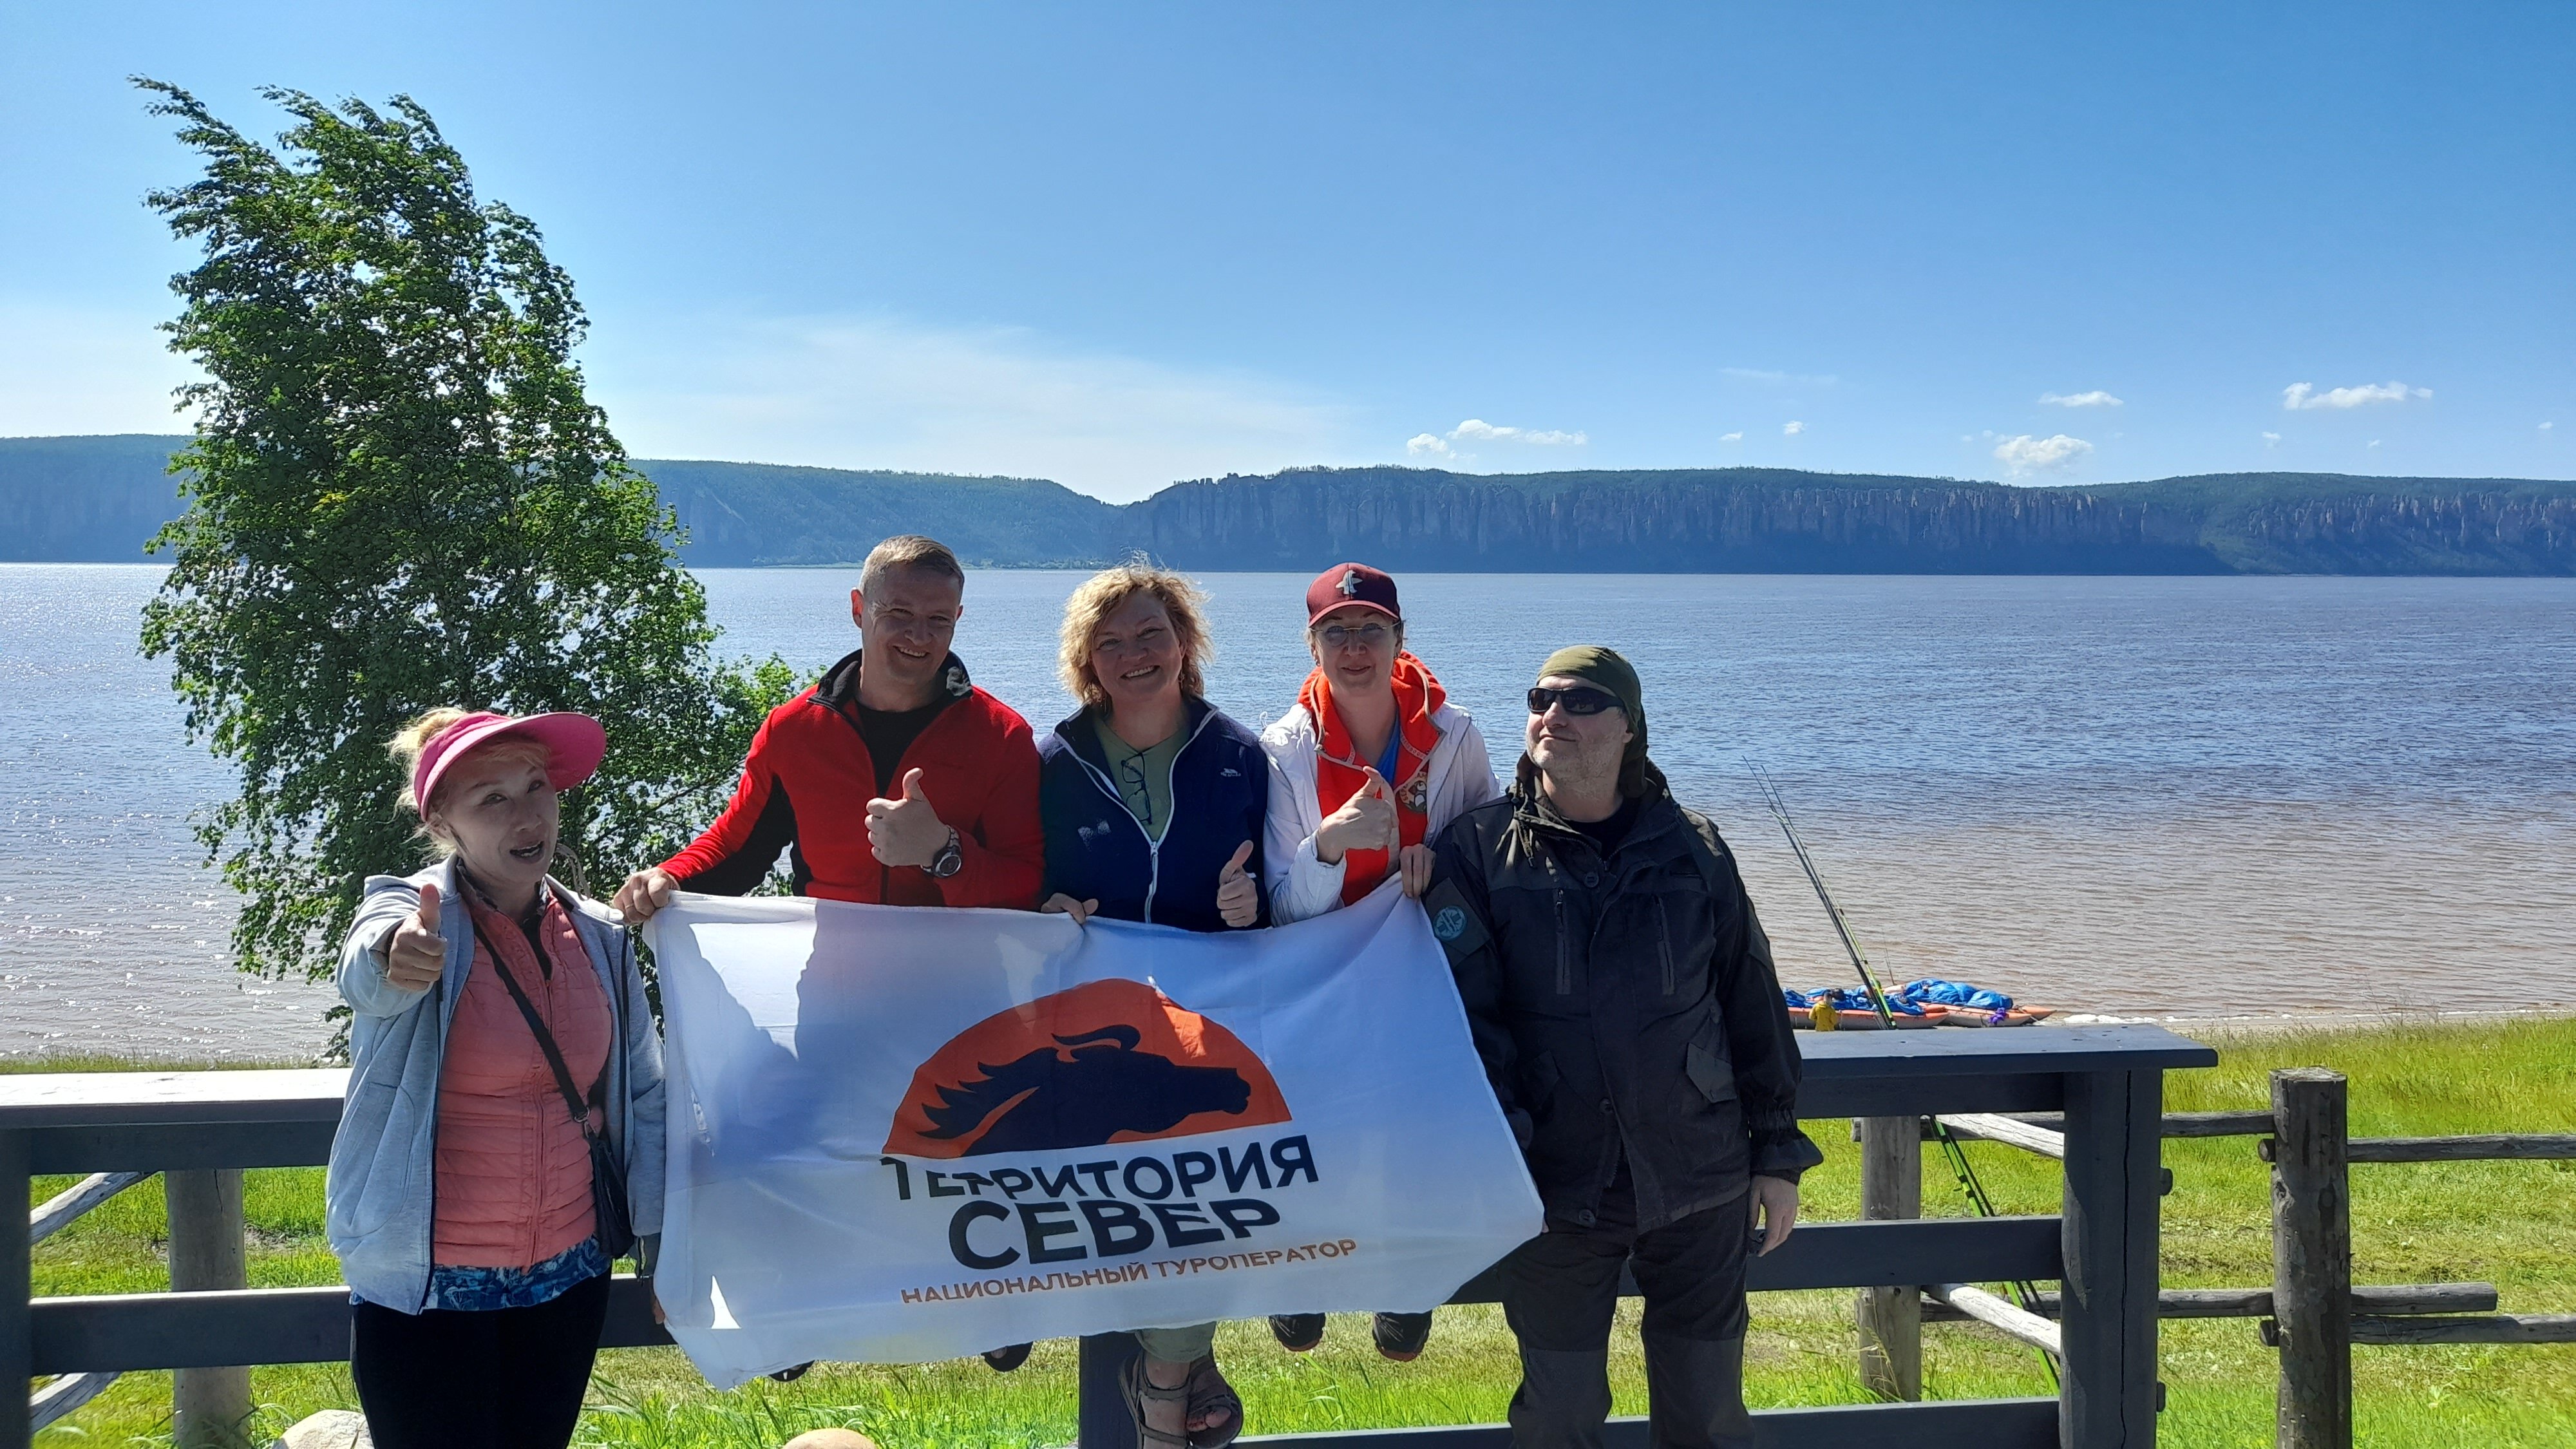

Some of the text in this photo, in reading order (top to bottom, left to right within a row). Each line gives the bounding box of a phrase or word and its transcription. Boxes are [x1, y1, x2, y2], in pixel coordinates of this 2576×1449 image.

[949, 1198, 1280, 1270] СЕВЕР
[901, 1238, 1357, 1303] НАЦИОНАЛЬНЫЙ ТУРОПЕРАТОР
